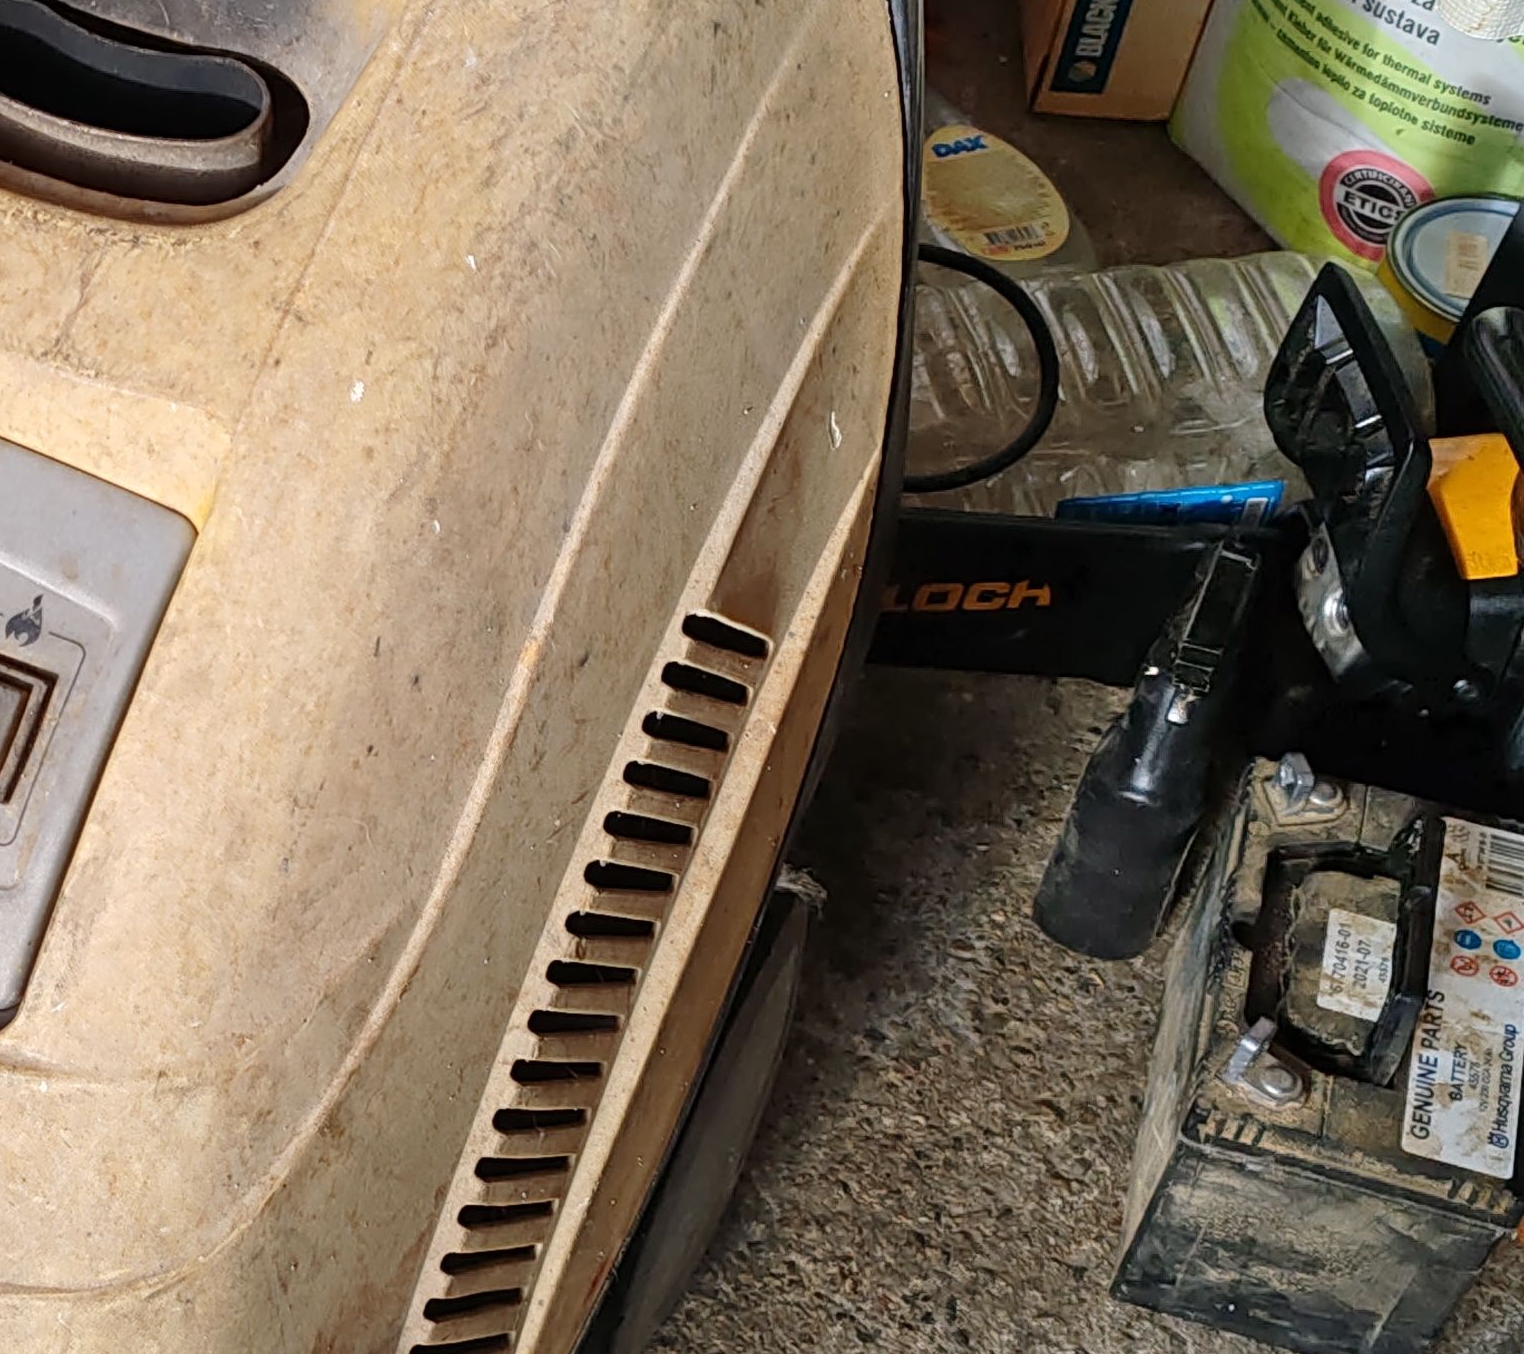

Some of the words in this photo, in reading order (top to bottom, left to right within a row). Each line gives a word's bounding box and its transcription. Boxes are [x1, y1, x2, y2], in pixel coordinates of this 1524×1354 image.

[1362, 43, 1381, 61] for
[1382, 54, 1432, 85] thermal
[1433, 79, 1492, 106] systems
[1352, 85, 1367, 100] za
[1421, 119, 1476, 145] sisteme
[1352, 939, 1373, 990] 2021-07
[1420, 989, 1445, 1051] PARTS
[1498, 1023, 1519, 1063] Group
[1410, 1054, 1438, 1140] GENUINE
[1448, 1039, 1468, 1102] BATTERY
[1492, 1064, 1513, 1133] Husqvarna
